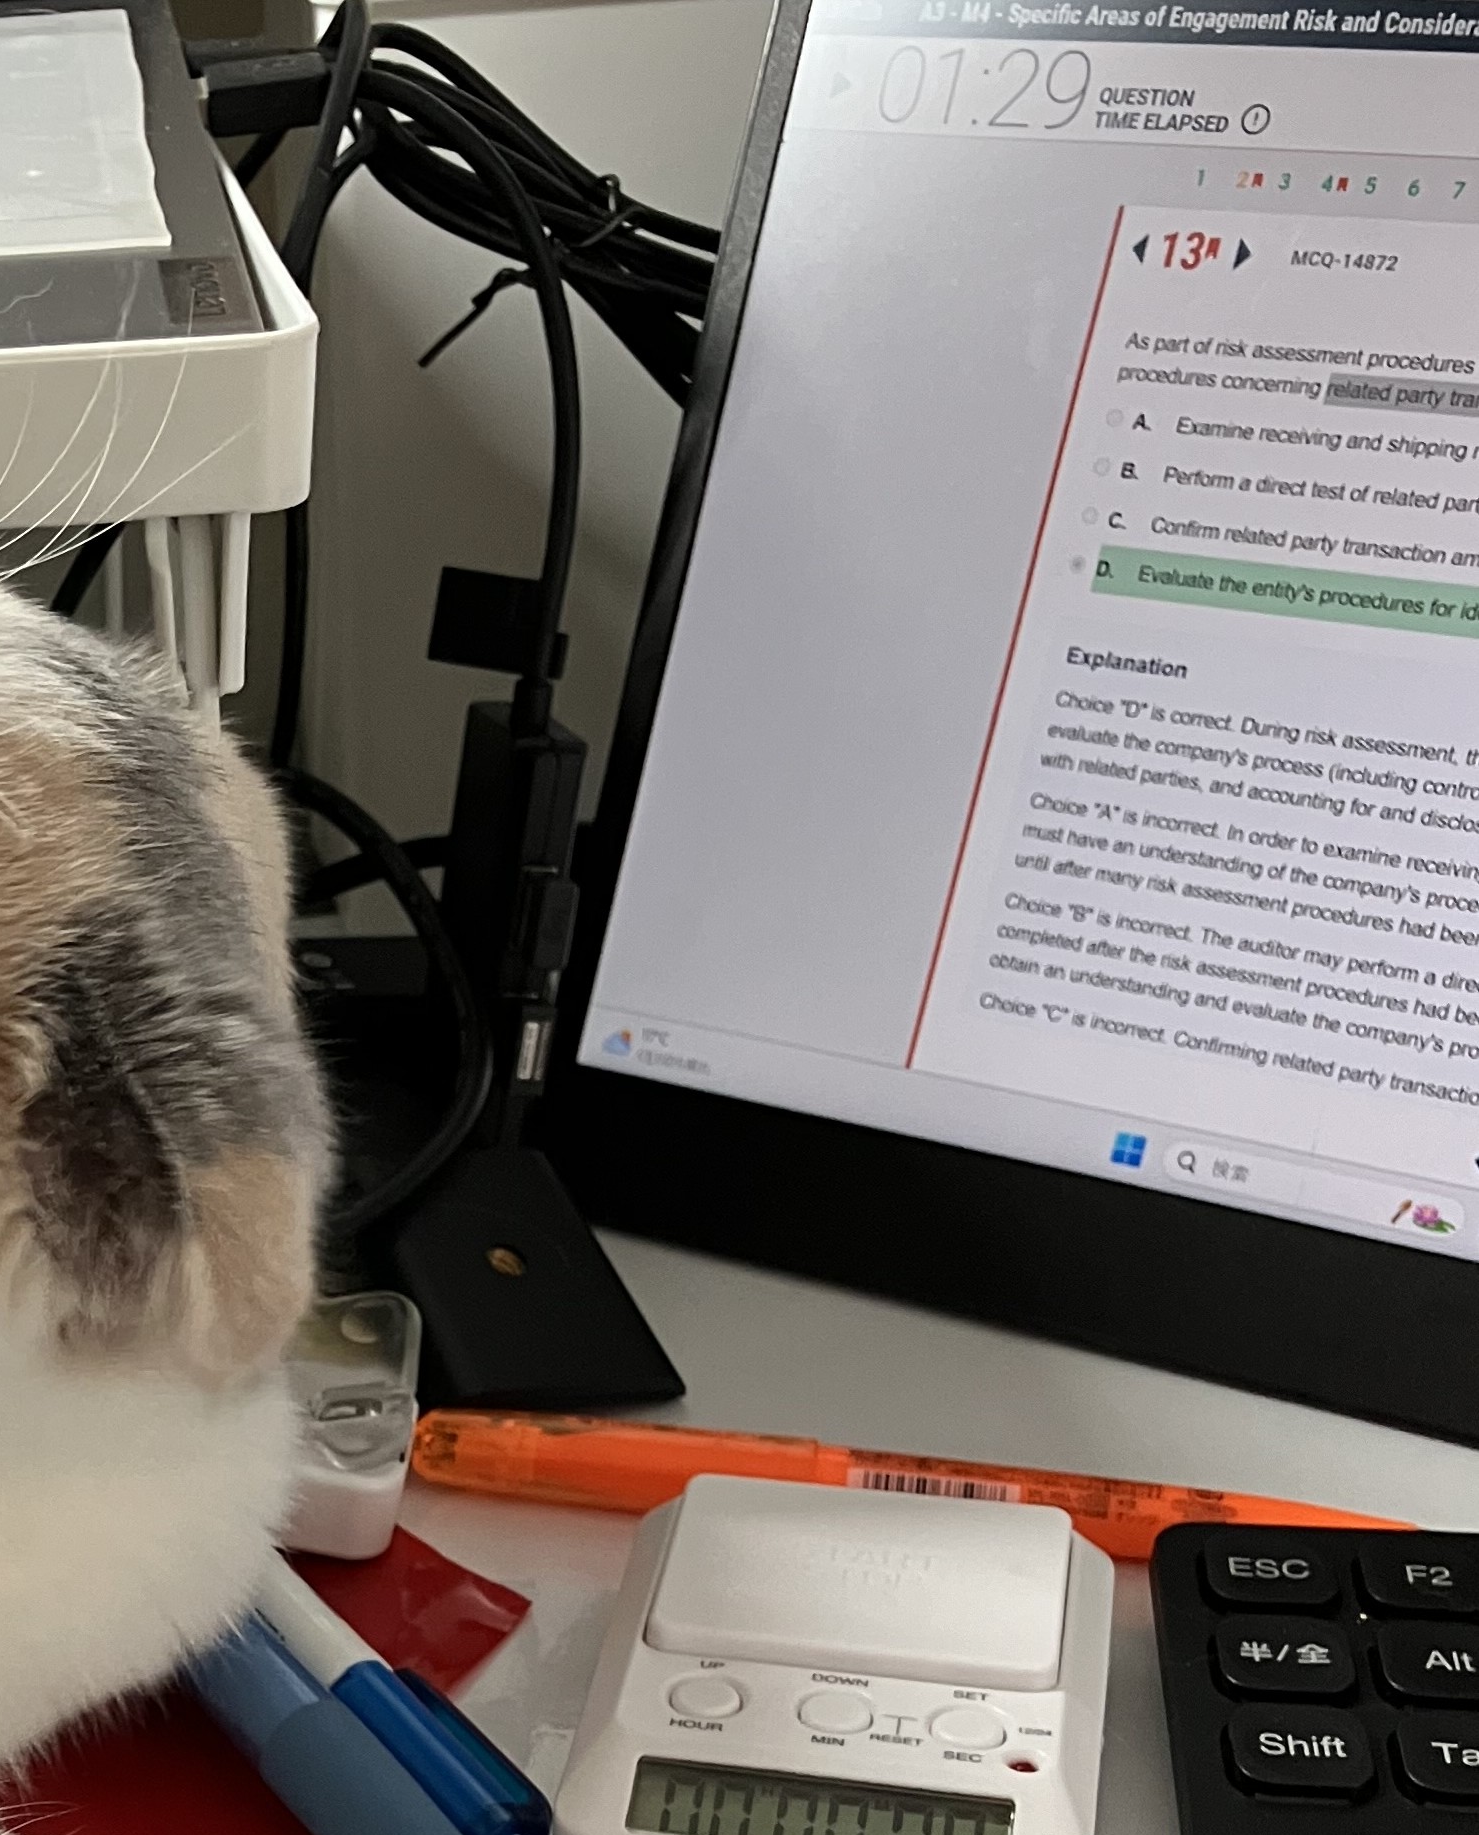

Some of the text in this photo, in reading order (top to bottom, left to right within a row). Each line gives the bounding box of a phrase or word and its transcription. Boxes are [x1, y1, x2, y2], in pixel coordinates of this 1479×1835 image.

[1008, 3, 1082, 29] Specific
[1084, 5, 1141, 26] Areas
[1144, 5, 1167, 27] of
[1168, 5, 1290, 34] Engagement
[1293, 8, 1337, 32] Risk
[1341, 9, 1381, 33] and
[878, 46, 1093, 131] 01:29
[1099, 87, 1196, 107] QUESTION
[1095, 110, 1230, 133] TIME ELAPSED
[1197, 169, 1467, 200] 1 3 4 5 6 7
[1163, 231, 1204, 271] 13
[1290, 250, 1399, 272] MCQ-14872
[1125, 333, 1475, 374] As part of risk assessment procedures
[1117, 366, 1217, 388] procedures
[1221, 375, 1322, 400] concerning
[1323, 381, 1393, 405] related
[1395, 388, 1445, 410] party
[1176, 416, 1254, 440] Examine
[1258, 428, 1343, 452] receiving
[1346, 434, 1384, 452] and
[1386, 436, 1468, 463] shipping
[1163, 466, 1235, 490] Perform
[1238, 478, 1252, 491] a
[1255, 477, 1307, 497] direct
[1311, 482, 1346, 500] test
[1349, 485, 1370, 502] of
[1373, 488, 1440, 509] related
[1151, 517, 1220, 539] Confirm
[1224, 527, 1288, 547] related
[1290, 535, 1339, 556] party
[1342, 538, 1447, 563] transaction
[1138, 564, 1214, 590] Evaluate
[1219, 575, 1247, 594] the
[1251, 582, 1315, 604] entity's
[1318, 590, 1424, 615] procedures
[1429, 598, 1457, 617] for
[1066, 646, 1187, 679] Explanation
[1055, 690, 1114, 714] Choice
[1148, 706, 1167, 722] is
[1241, 717, 1300, 745] During
[1304, 730, 1337, 747] risk
[1228, 1556, 1310, 1579] ESC
[1405, 1565, 1453, 1586] F2
[1425, 1650, 1475, 1672] Alt
[811, 1670, 873, 1688] DOWN
[953, 1690, 988, 1702] SET
[669, 1717, 723, 1732] HOUR
[810, 1734, 845, 1747] MIN
[869, 1733, 922, 1746] RESET
[1259, 1732, 1347, 1758] Shift
[943, 1750, 982, 1764] SEC
